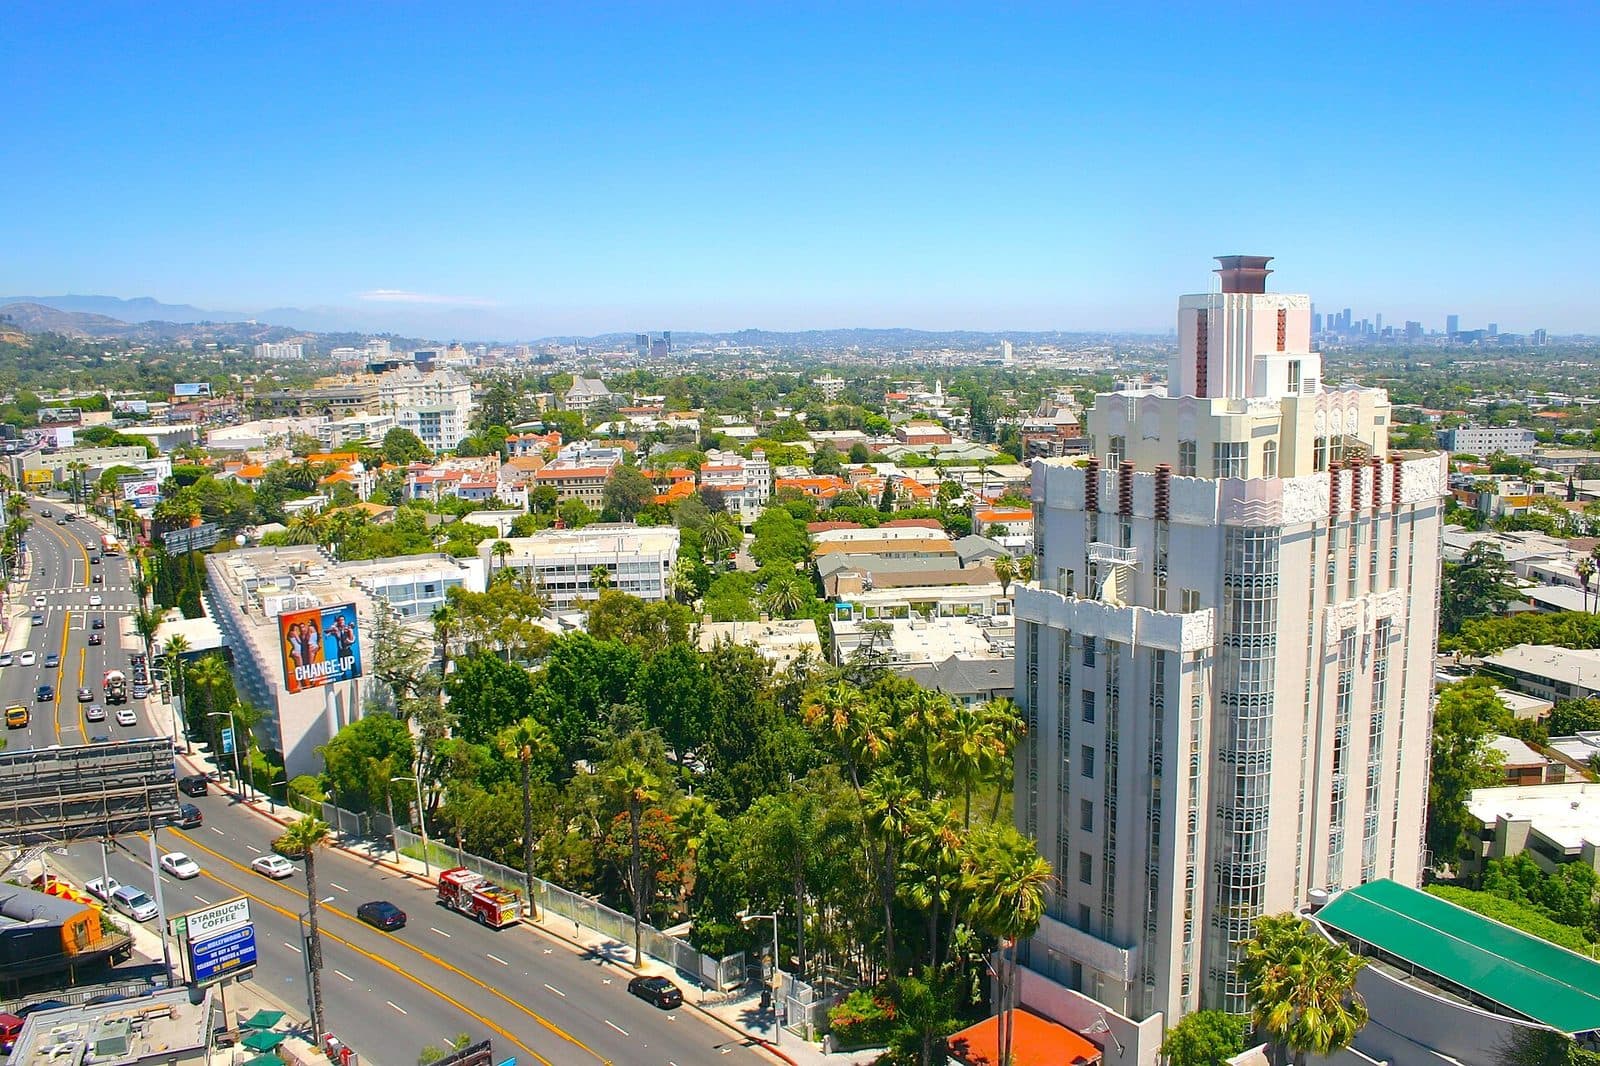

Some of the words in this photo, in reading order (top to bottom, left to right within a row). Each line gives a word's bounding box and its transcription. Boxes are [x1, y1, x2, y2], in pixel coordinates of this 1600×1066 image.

[295, 656, 355, 680] CHANGE-UP
[191, 901, 246, 925] STARBUCKS
[202, 912, 236, 929] COFFEE
